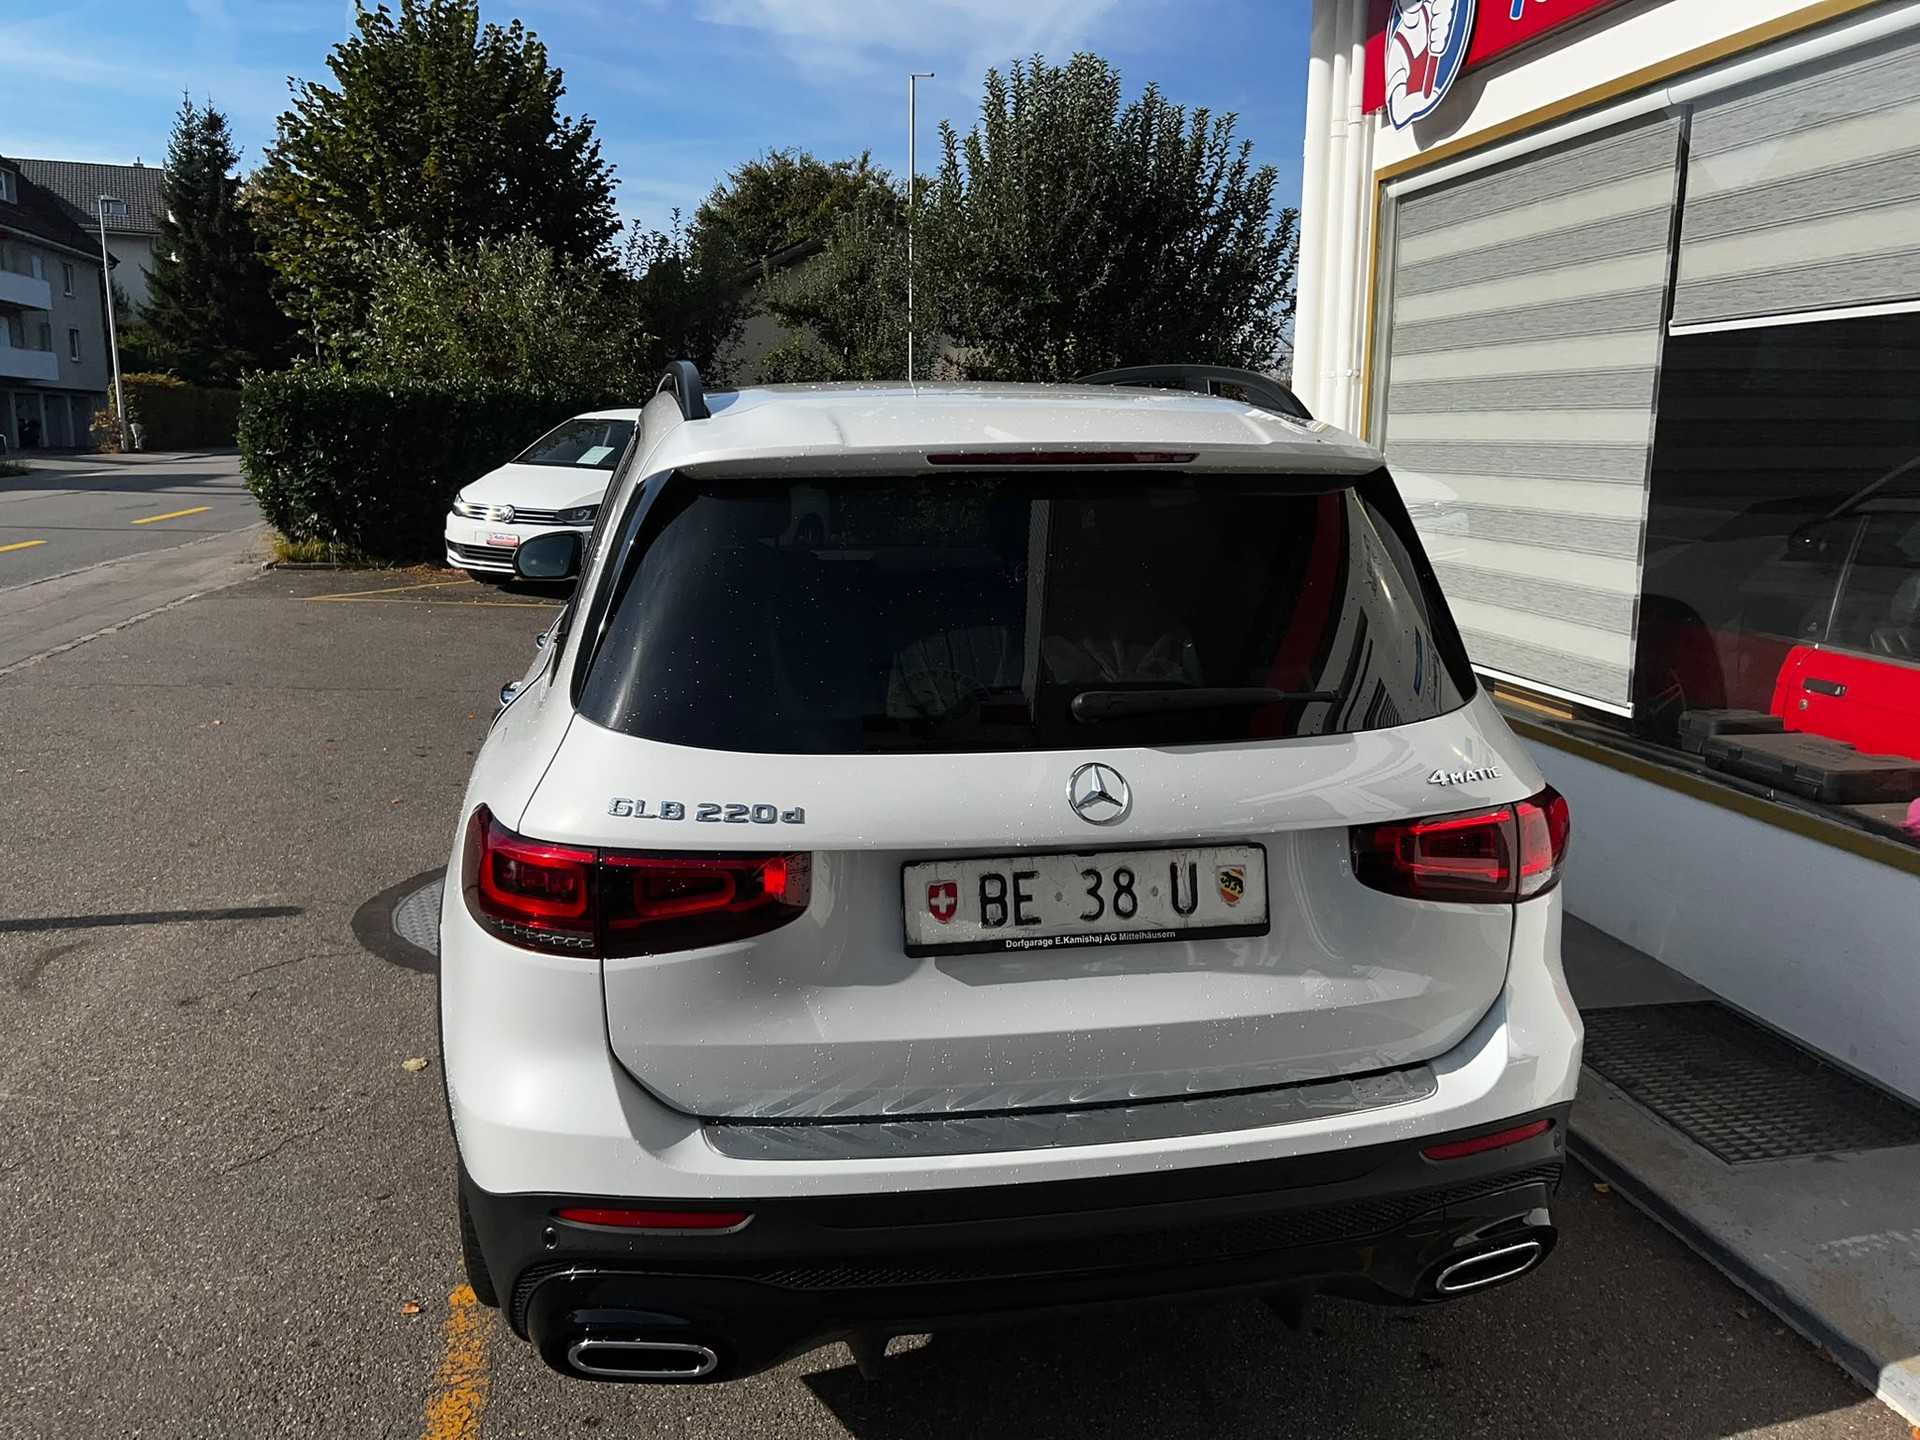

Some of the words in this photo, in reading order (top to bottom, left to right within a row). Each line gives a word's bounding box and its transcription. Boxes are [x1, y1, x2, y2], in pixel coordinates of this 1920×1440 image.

[1427, 766, 1503, 786] 4MATIC
[608, 797, 686, 820] GLB
[695, 803, 805, 824] 220d
[979, 870, 1041, 928] BE
[1079, 867, 1138, 921] 38
[1170, 862, 1198, 917] U
[1005, 938, 1053, 949] Dorfgarage
[1055, 935, 1102, 944] E.Kamishaj
[1104, 933, 1117, 942] AG
[1119, 931, 1176, 941] Mittelhäusern
